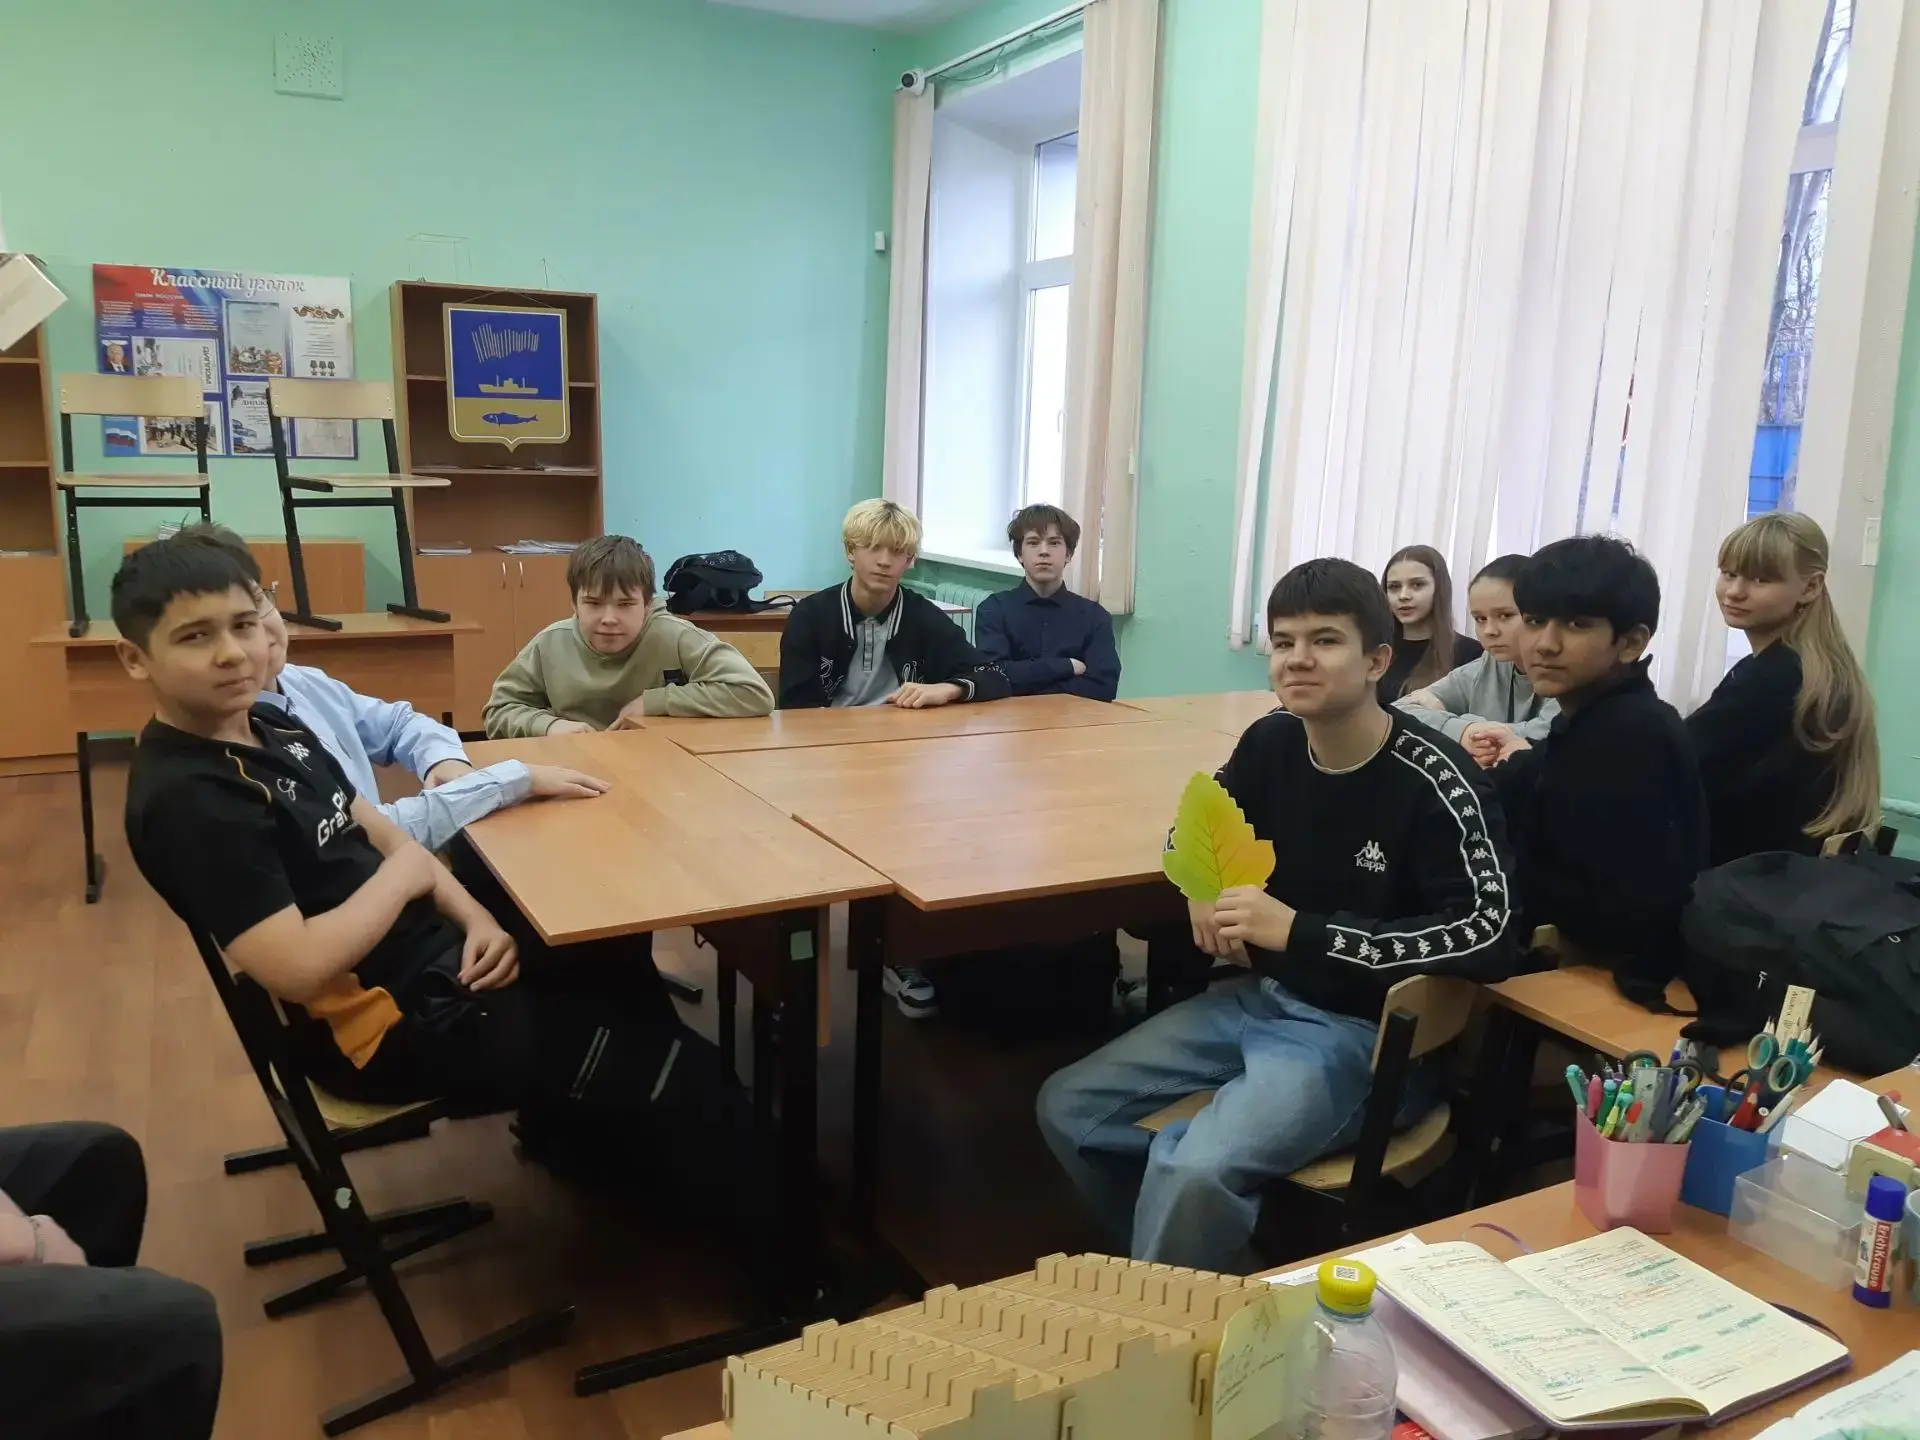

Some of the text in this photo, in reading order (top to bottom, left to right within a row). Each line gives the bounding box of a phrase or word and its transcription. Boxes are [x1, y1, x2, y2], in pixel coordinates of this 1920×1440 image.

[150, 268, 305, 298] Классный уголок
[1356, 857, 1385, 872] Kappa
[1870, 1223, 1891, 1288] ErichKrause
